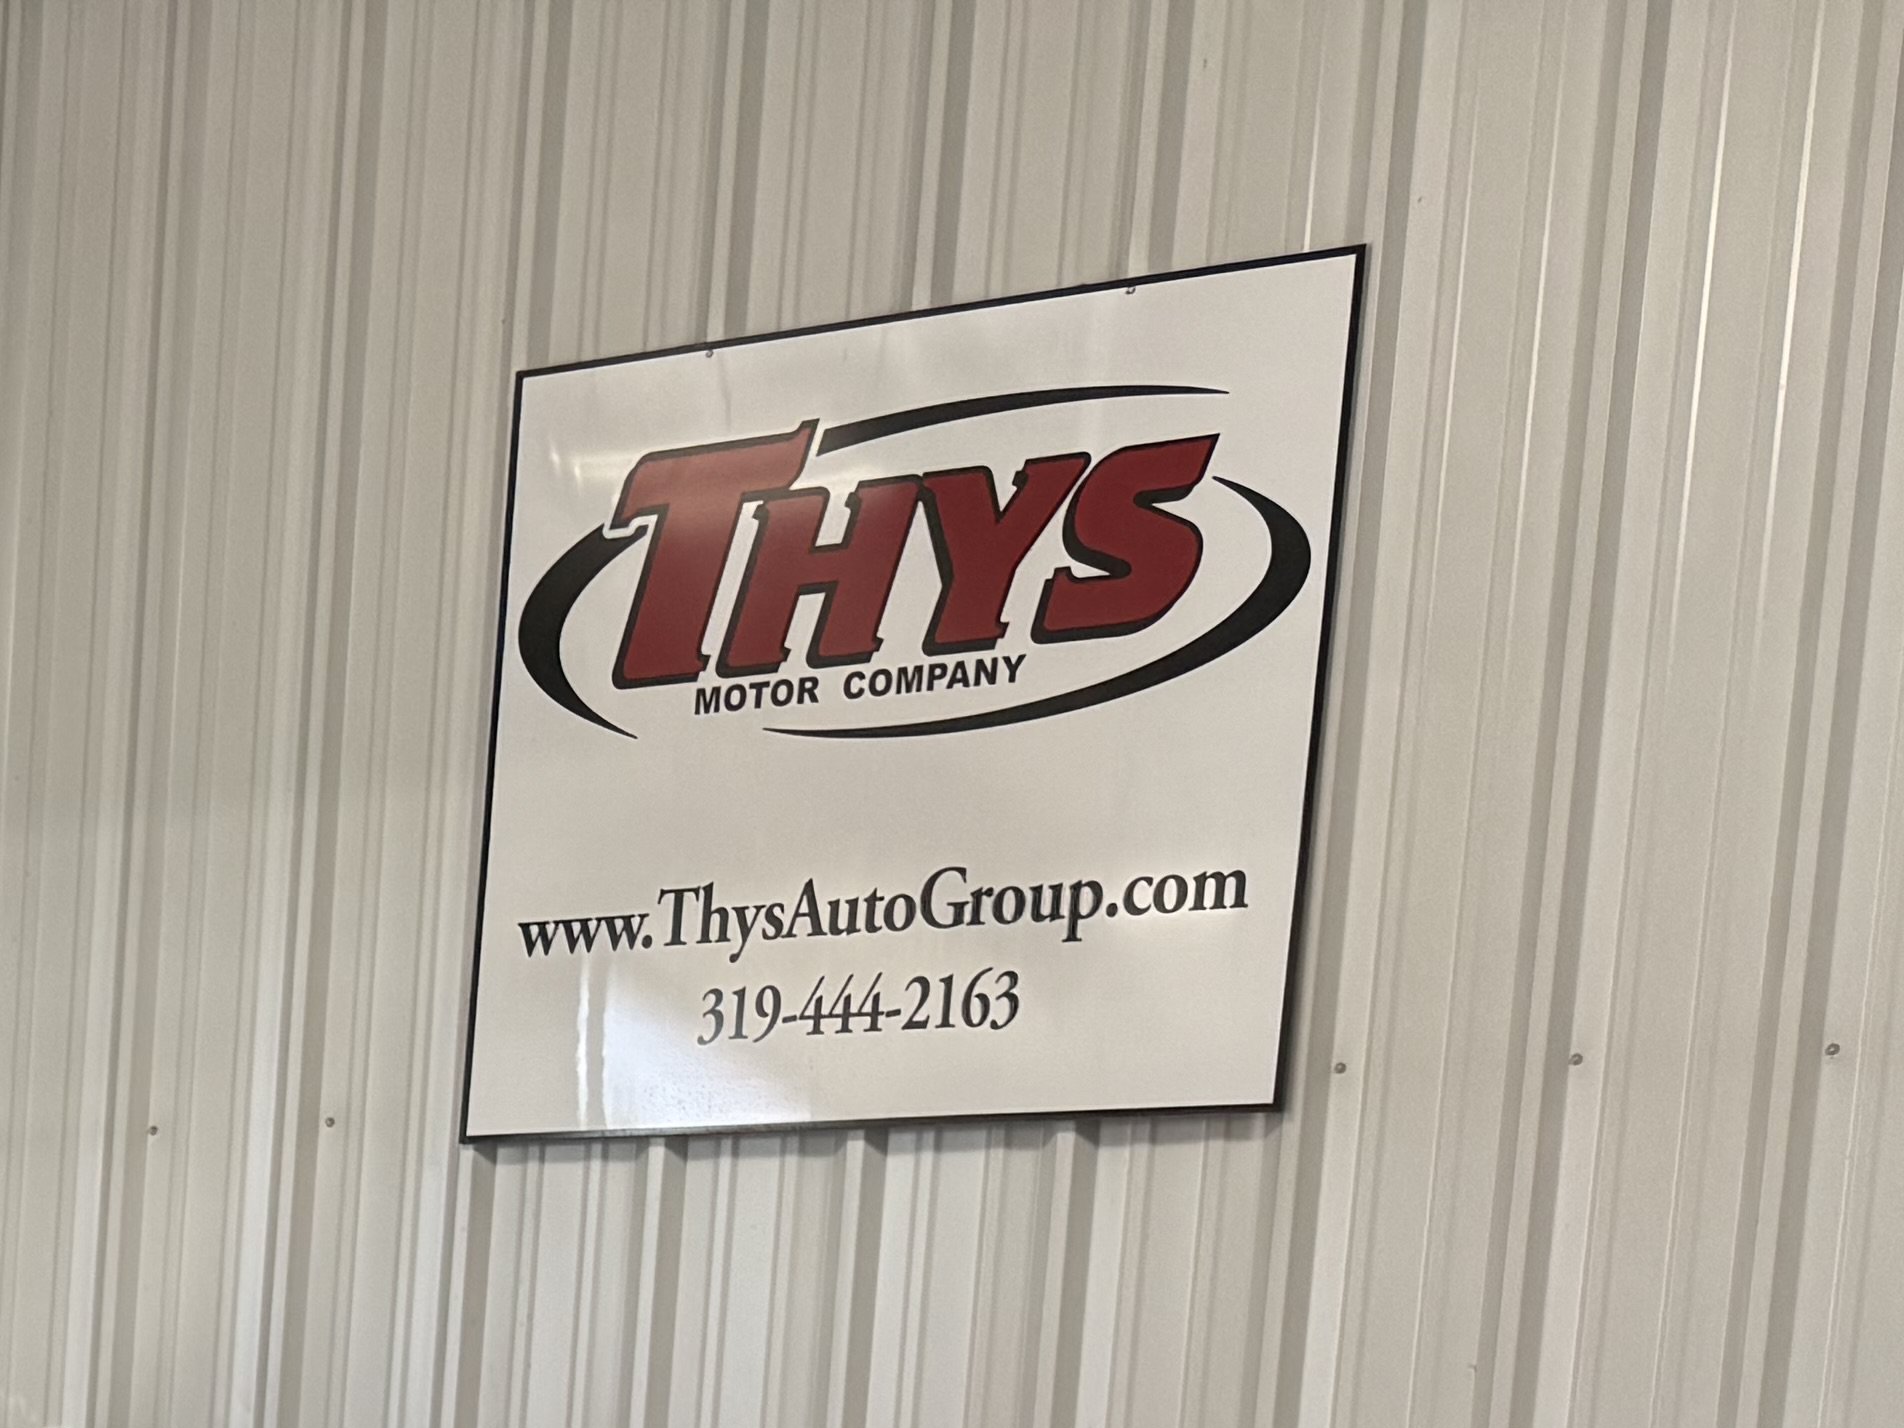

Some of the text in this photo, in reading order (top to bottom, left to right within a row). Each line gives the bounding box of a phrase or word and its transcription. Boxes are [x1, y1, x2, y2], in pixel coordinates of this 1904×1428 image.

[609, 418, 1220, 690] THYS
[693, 653, 1027, 716] MOTOR COMPANY
[517, 866, 1249, 964] www.ThysAutoGroup.com
[696, 966, 1021, 1046] 319-444-2163
